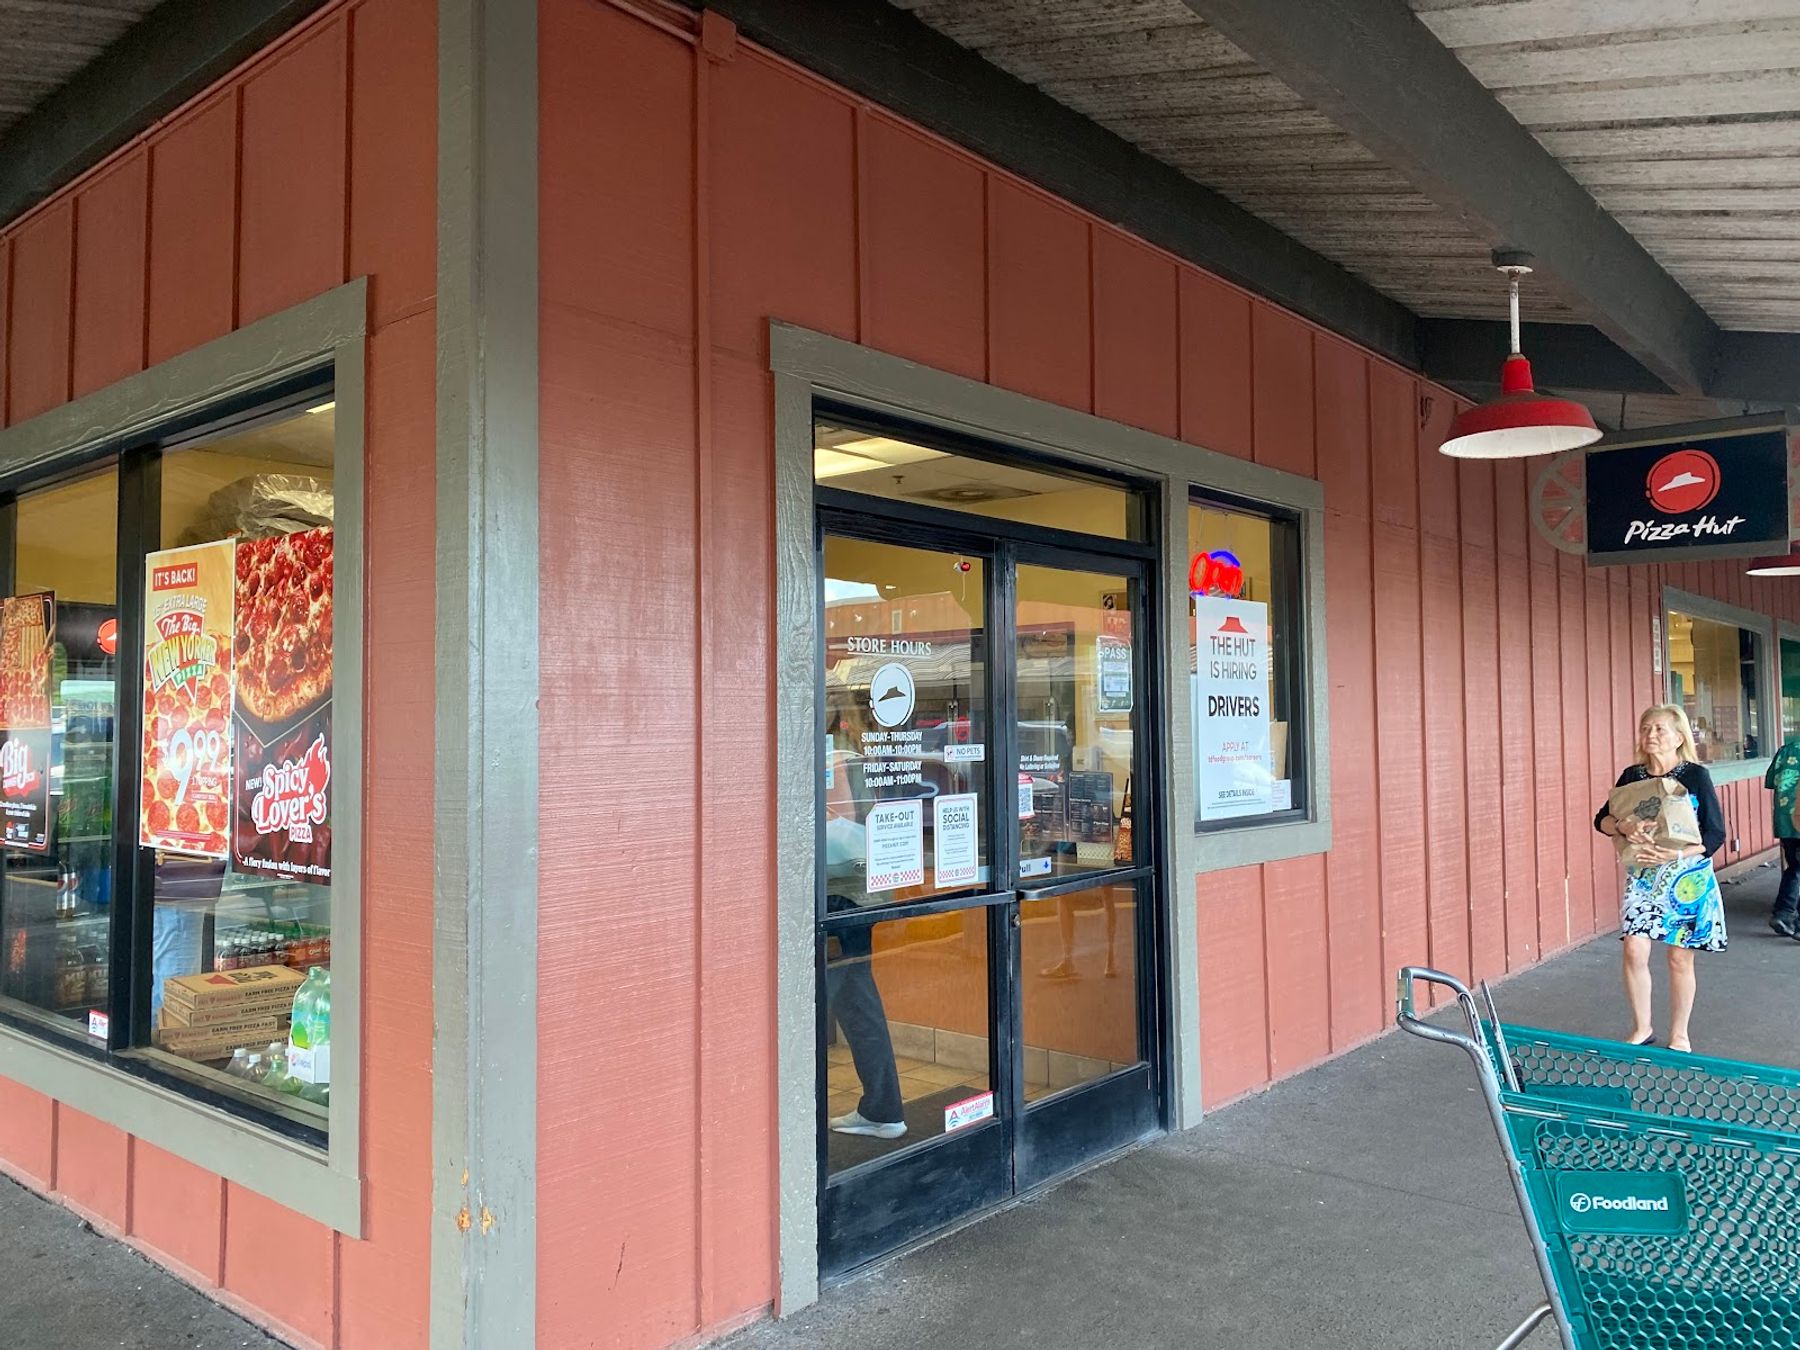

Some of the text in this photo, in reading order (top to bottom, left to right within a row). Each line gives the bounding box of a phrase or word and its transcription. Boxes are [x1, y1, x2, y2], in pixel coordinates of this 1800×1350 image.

[1623, 515, 1747, 545] Pizza Hut
[154, 567, 196, 587] IT'S BACK!
[1189, 551, 1244, 598] Open
[161, 613, 200, 638] The Big
[847, 636, 932, 656] STORE HOURS
[1104, 647, 1127, 660] PASS
[1210, 635, 1256, 657] THE HUT
[150, 634, 216, 690] NEW YORKER
[1210, 660, 1257, 680] IS HIRING
[173, 663, 204, 686] PIZZA
[1208, 695, 1260, 717] DRIVERS
[861, 731, 922, 743] SUNDAY-THURSDAY
[863, 744, 922, 756] 10:00AM-10:00PM
[967, 747, 980, 755] PETS
[1222, 741, 1249, 752] APPLY AT
[1, 737, 28, 789] Big
[863, 761, 922, 773] FRIDAY-SATURDAY
[245, 776, 263, 791] NEW!
[263, 765, 310, 801] Spicy
[864, 773, 922, 789] 10:00AM-11:00PM
[253, 783, 324, 827] Lover's
[875, 810, 915, 824] TAKE-OUT
[942, 812, 970, 824] SOCIAL
[290, 827, 311, 840] PIZZA
[279, 860, 290, 872] with
[291, 861, 307, 874] layers
[313, 864, 331, 877] flavor
[1592, 1196, 1669, 1212] Foodland
